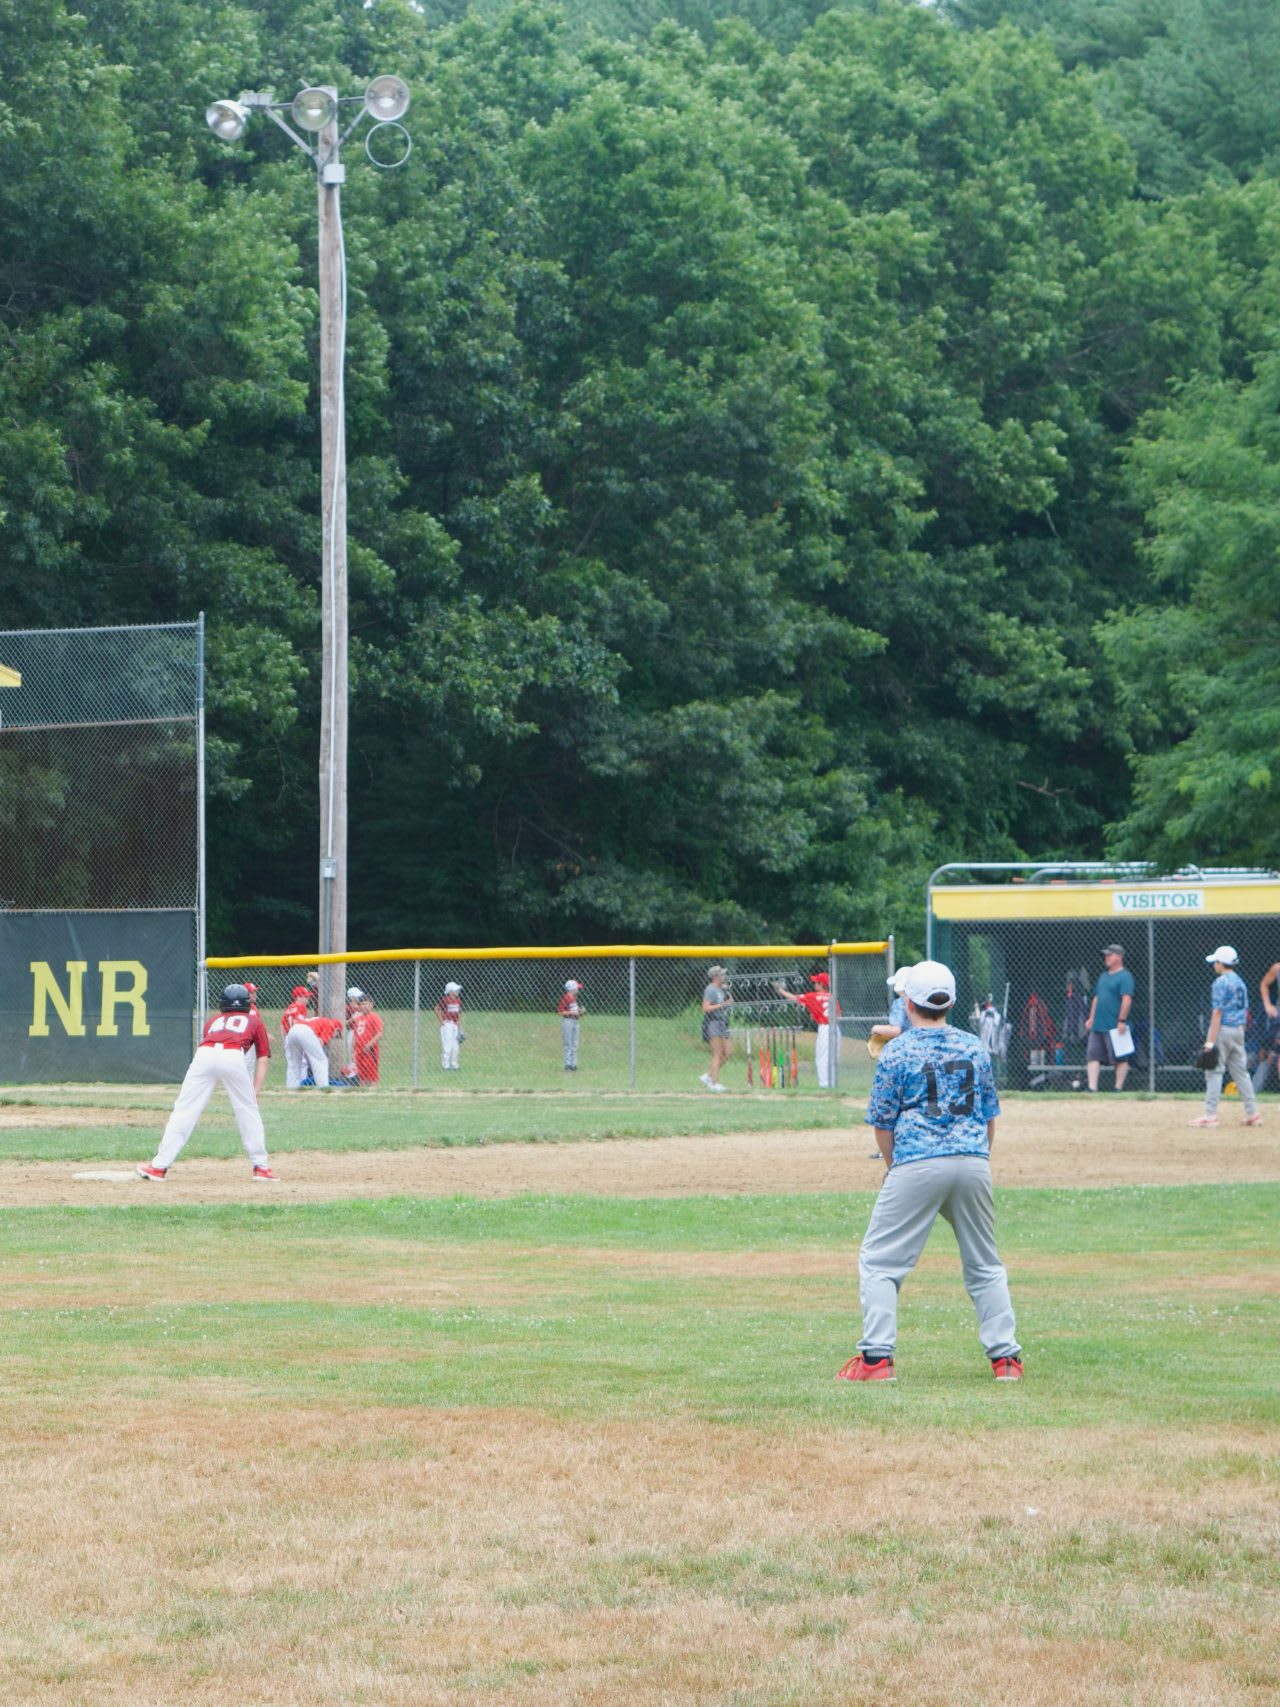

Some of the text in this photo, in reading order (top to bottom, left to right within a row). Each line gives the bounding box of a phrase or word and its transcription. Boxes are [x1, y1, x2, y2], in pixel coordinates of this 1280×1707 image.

[1118, 893, 1199, 908] VISITOR
[29, 960, 150, 1036] NR
[921, 1060, 976, 1116] 13
